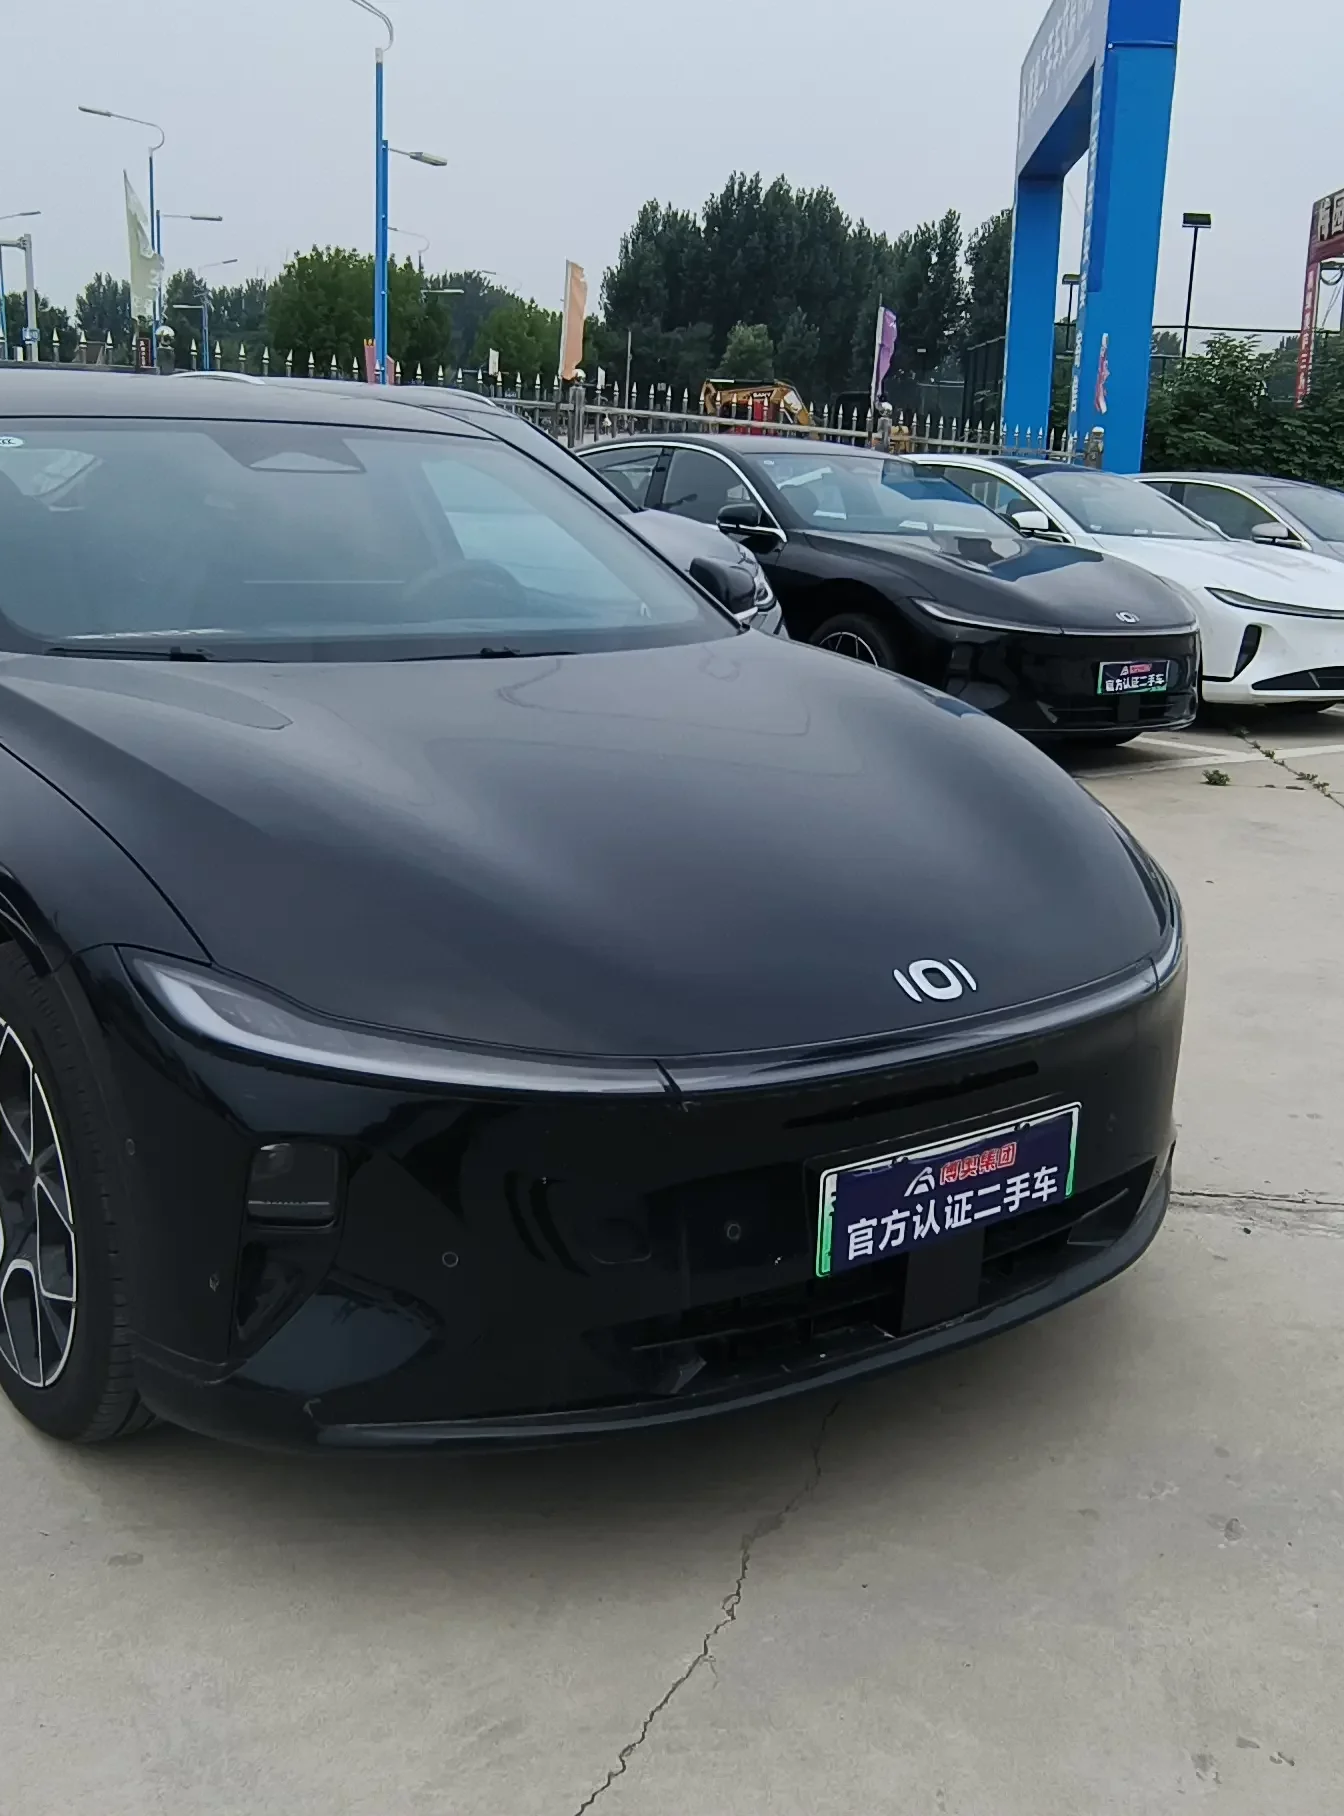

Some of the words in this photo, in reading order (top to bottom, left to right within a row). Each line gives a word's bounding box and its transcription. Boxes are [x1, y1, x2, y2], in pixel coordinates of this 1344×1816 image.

[847, 1165, 1058, 1260] 官方认证二手车
